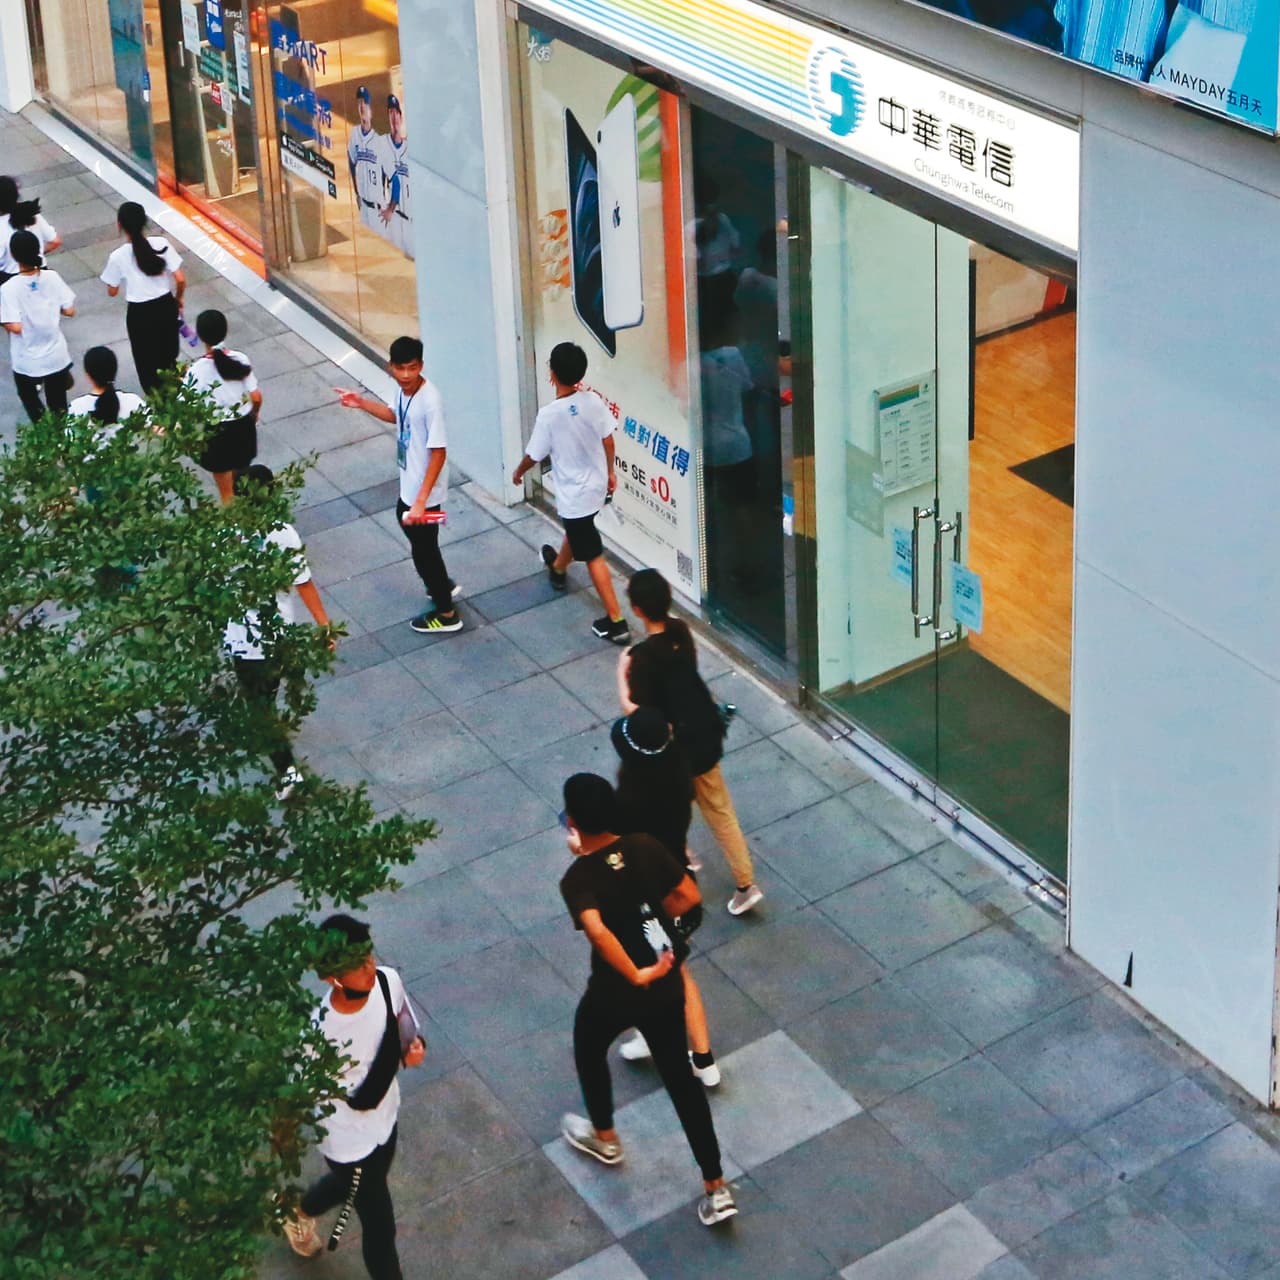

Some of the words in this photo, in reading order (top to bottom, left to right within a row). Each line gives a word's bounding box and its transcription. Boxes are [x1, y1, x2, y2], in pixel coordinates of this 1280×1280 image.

[1113, 49, 1167, 81] 品牌代人
[877, 96, 1016, 188] 中華電信
[914, 157, 969, 193] Chunghwa
[971, 180, 1014, 213] Telecom
[623, 415, 690, 477] 絕對值得
